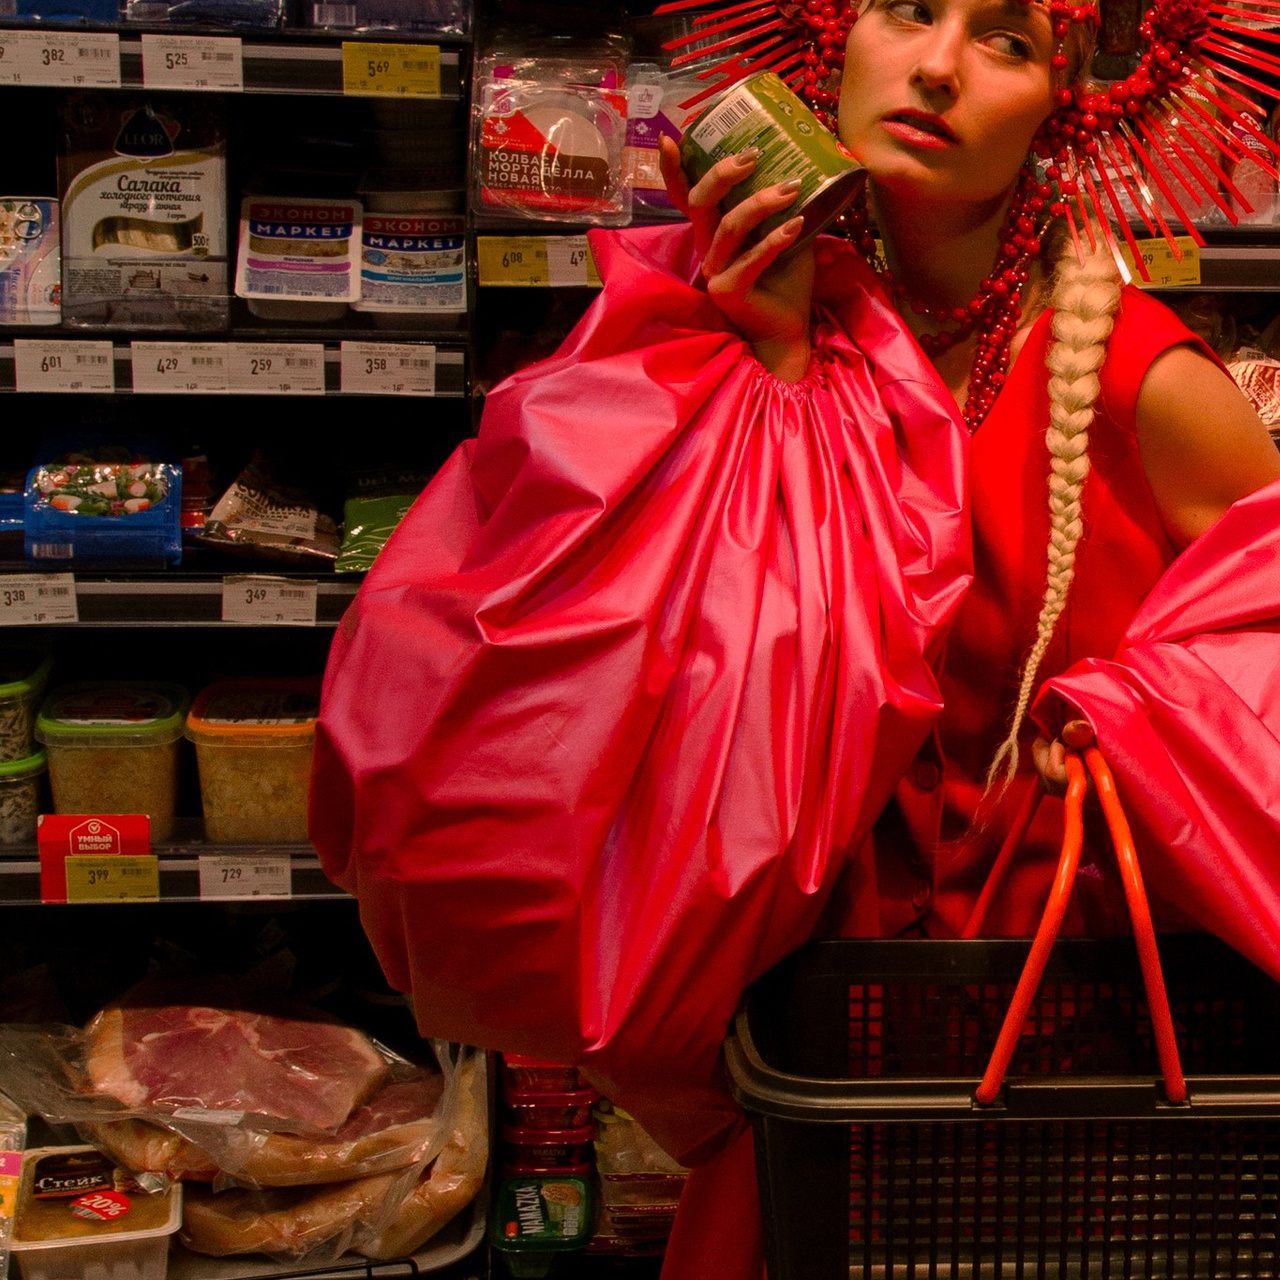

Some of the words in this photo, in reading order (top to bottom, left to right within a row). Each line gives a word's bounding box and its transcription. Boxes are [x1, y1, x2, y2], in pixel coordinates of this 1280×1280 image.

[488, 150, 561, 168] КОЛБАСА
[488, 162, 595, 181] МОРТАДЕЛЛА
[488, 172, 541, 185] НОВАЯ
[117, 174, 182, 194] Салака
[258, 207, 347, 220] ЭКОНОМ
[256, 222, 345, 237] МАРКЕТ
[371, 220, 458, 232] ЭКОНОМ
[369, 236, 456, 250] МАРКЕТ
[77, 834, 113, 844] УМНЫЙ
[77, 842, 112, 852] ВЫБОР
[36, 1176, 104, 1190] Стейк
[515, 1184, 545, 1235] NAMAZKA
